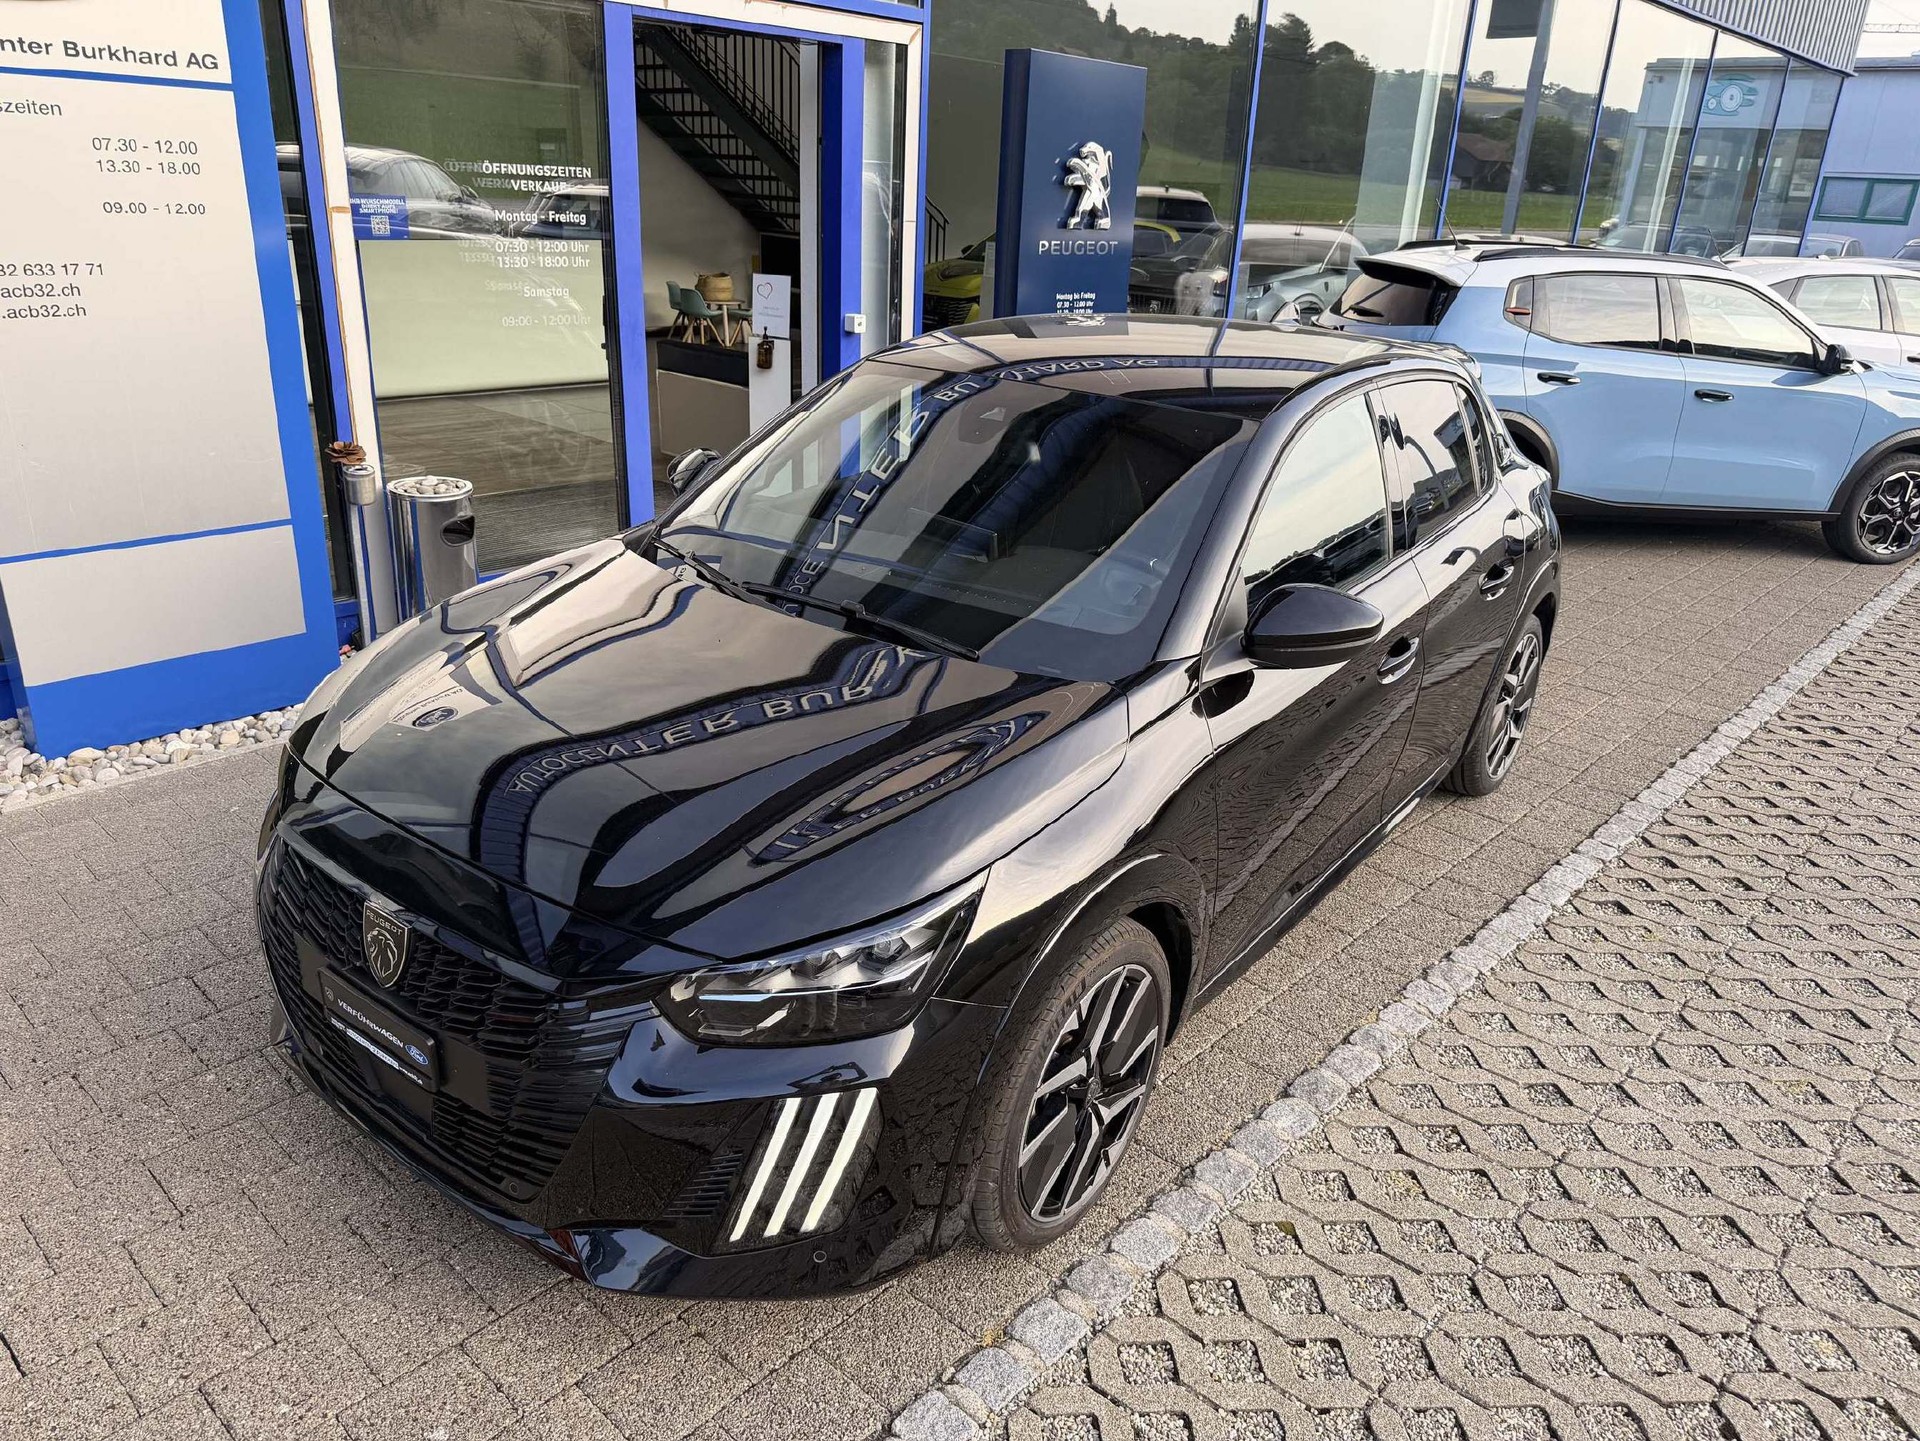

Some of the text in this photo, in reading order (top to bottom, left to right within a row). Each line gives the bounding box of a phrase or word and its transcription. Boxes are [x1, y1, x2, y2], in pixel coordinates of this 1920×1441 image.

[62, 40, 179, 67] Burkhard
[186, 52, 219, 70] AG
[92, 137, 137, 152] 07.30
[154, 140, 198, 155] 12.00
[96, 159, 140, 173] 13.30
[158, 162, 201, 175] 18.00
[482, 160, 592, 178] ÖFFNUNGSZEITEN
[511, 179, 567, 192] VERKAUF
[103, 201, 147, 214] 09.00
[164, 203, 206, 215] 12.00
[495, 209, 537, 224] Montag
[549, 210, 587, 225] Freitag
[495, 241, 528, 253] 07:30
[538, 241, 568, 252] 12:00
[571, 241, 590, 253] Uhr
[1038, 240, 1118, 255] PEUGEOT
[23, 263, 55, 276] 633
[61, 263, 79, 276] 17
[85, 263, 103, 276] 71
[497, 256, 528, 268] 13:30
[538, 256, 568, 267] 18:00
[572, 256, 591, 268] Uhr
[0, 283, 81, 298] acb32.ch
[523, 286, 570, 299] Samstag
[502, 316, 532, 327] 09:00
[543, 315, 571, 326] 12:00
[366, 909, 403, 936] PEUGEOT
